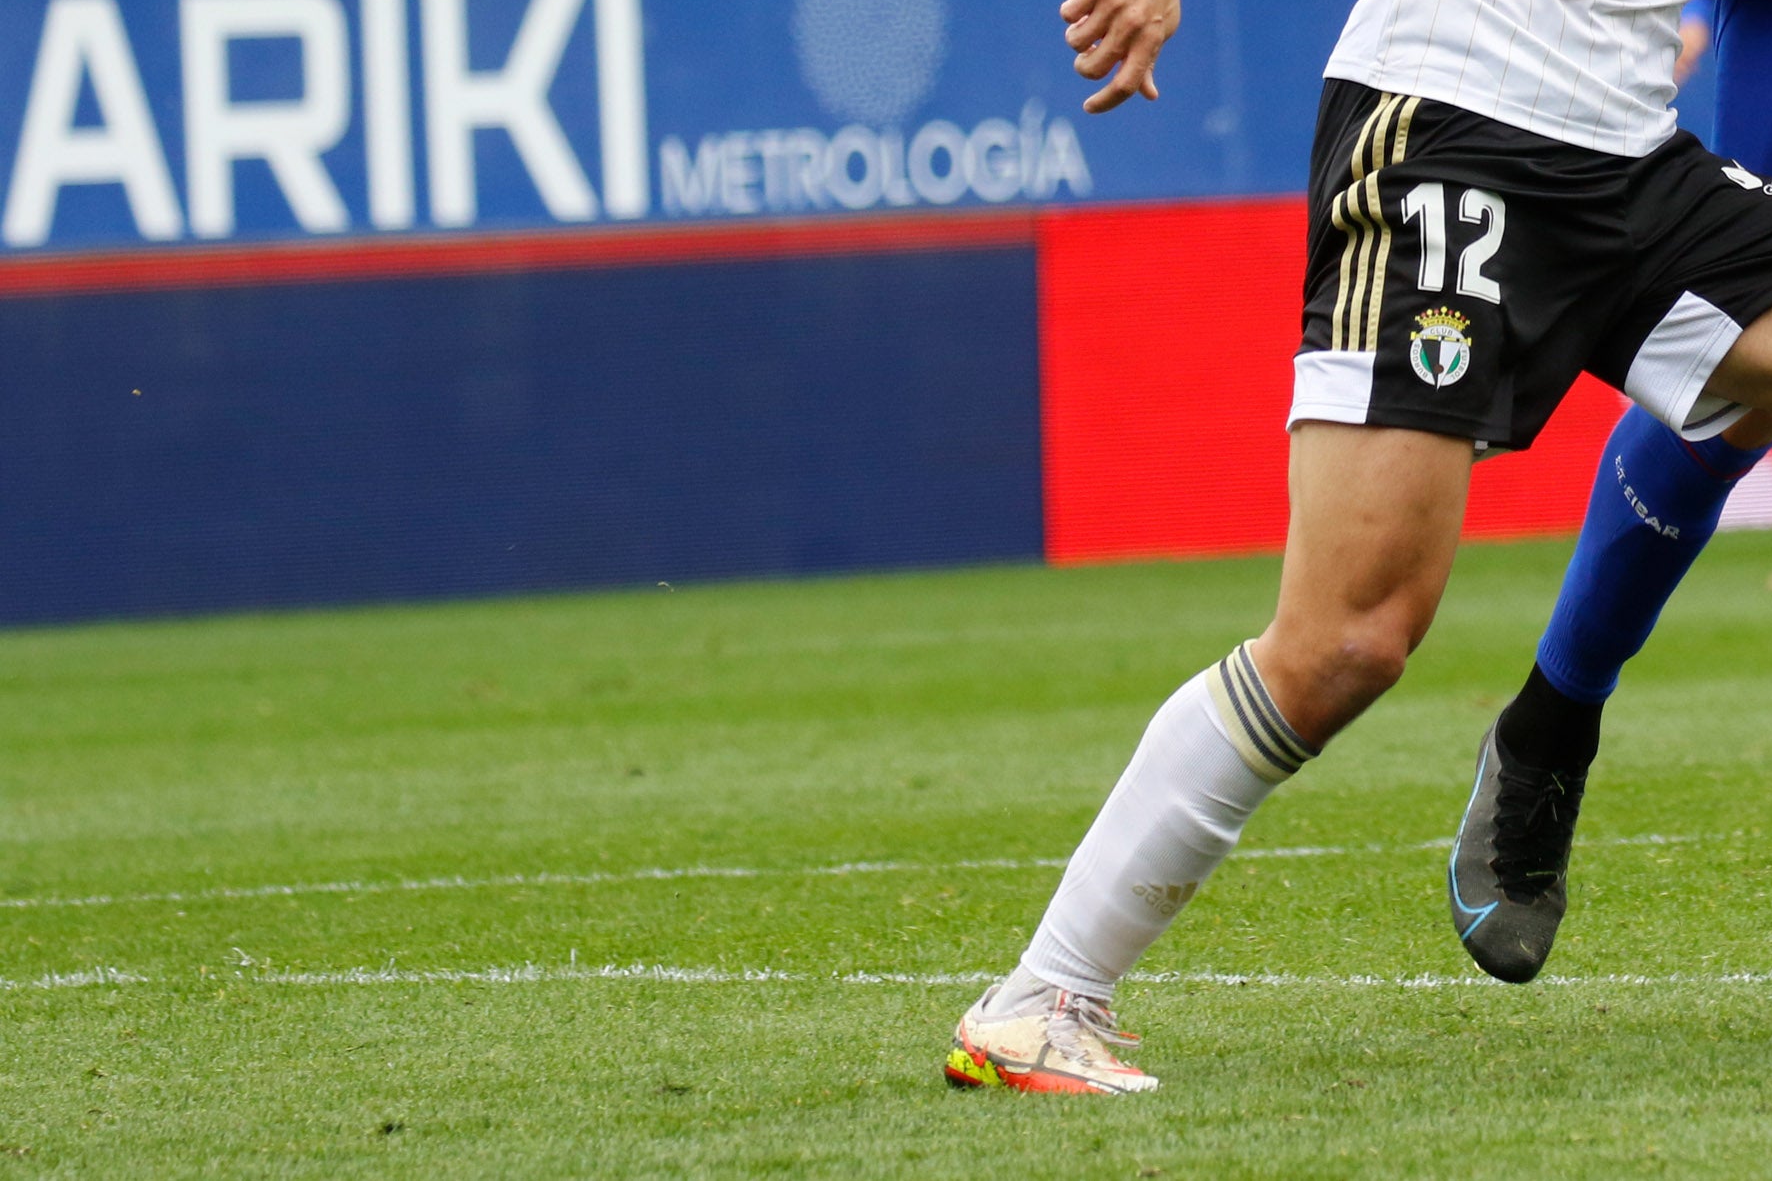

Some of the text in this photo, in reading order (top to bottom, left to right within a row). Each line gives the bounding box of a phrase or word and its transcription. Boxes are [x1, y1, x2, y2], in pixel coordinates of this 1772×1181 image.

[658, 97, 1095, 216] METROLOGÍA
[1401, 182, 1506, 305] 12
[1624, 486, 1680, 539] EIBAR
